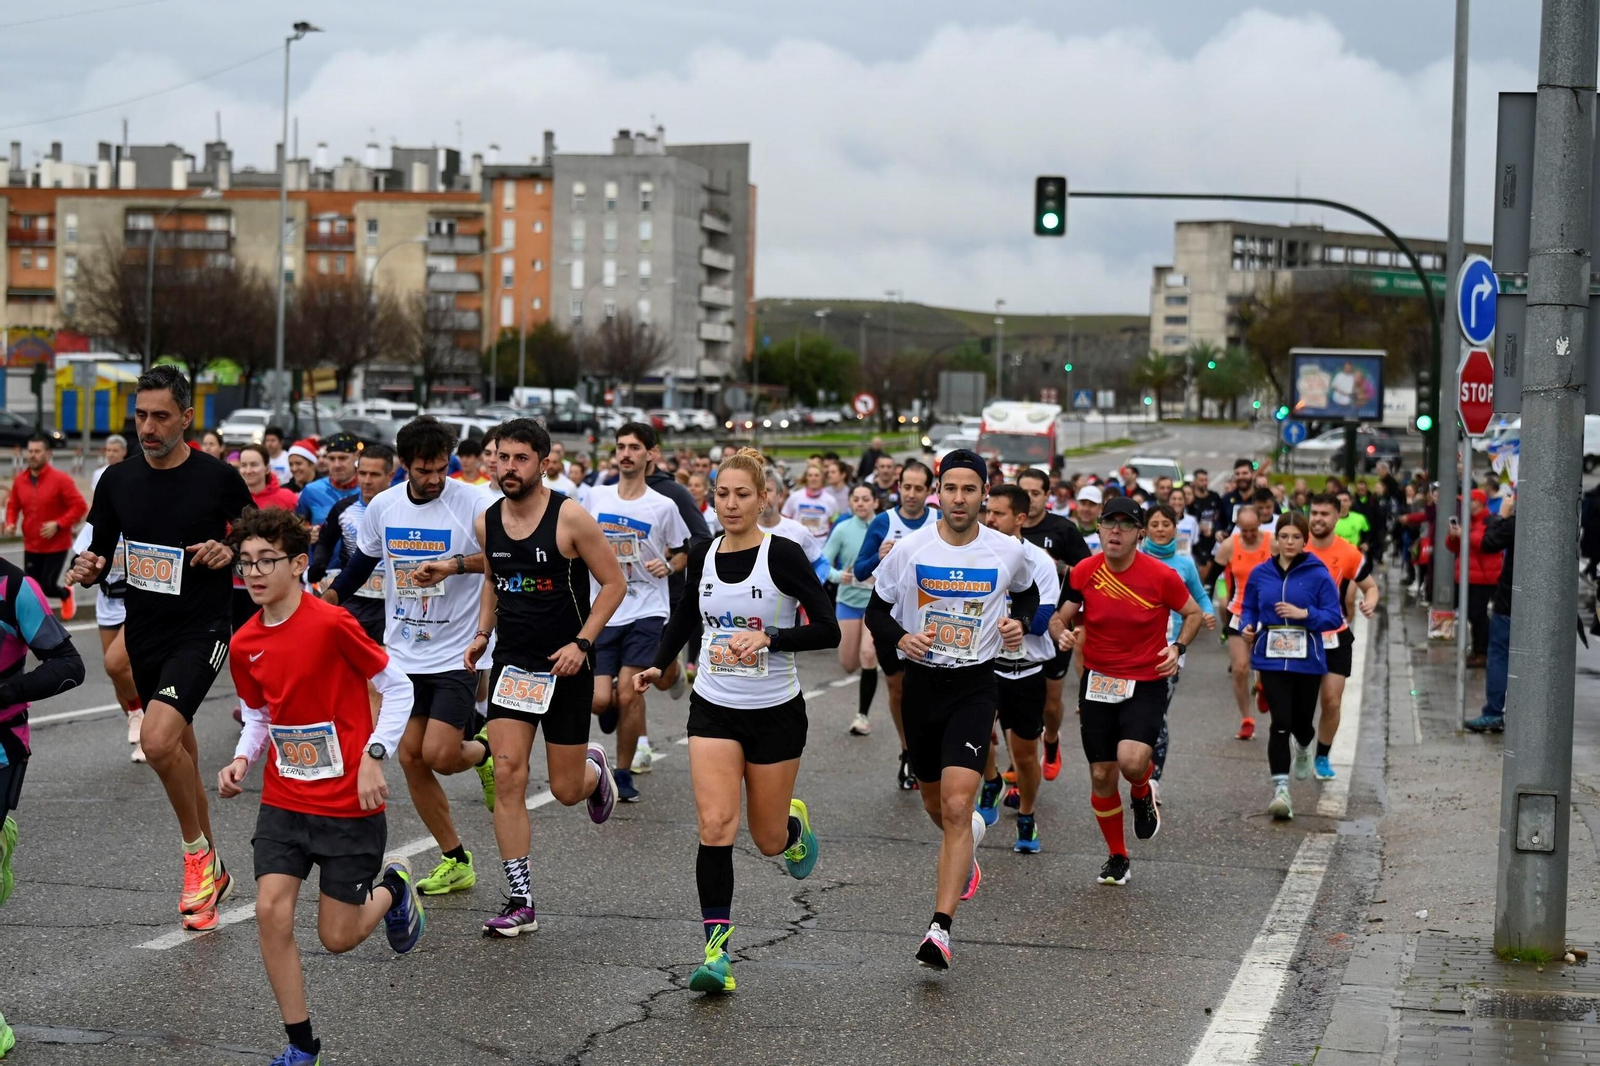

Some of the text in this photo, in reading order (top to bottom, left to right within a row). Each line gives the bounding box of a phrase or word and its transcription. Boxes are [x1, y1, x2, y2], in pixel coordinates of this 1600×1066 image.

[618, 517, 629, 526] 12
[408, 530, 422, 539] 12
[389, 539, 446, 551] CORDOBARIA
[128, 554, 172, 582] 260
[948, 570, 965, 580] 12
[395, 569, 419, 588] 21
[920, 577, 992, 593] CORDOBARIA
[704, 611, 763, 631] indea
[499, 676, 546, 703] 354
[1090, 675, 1127, 696] 273
[282, 741, 319, 767] 90
